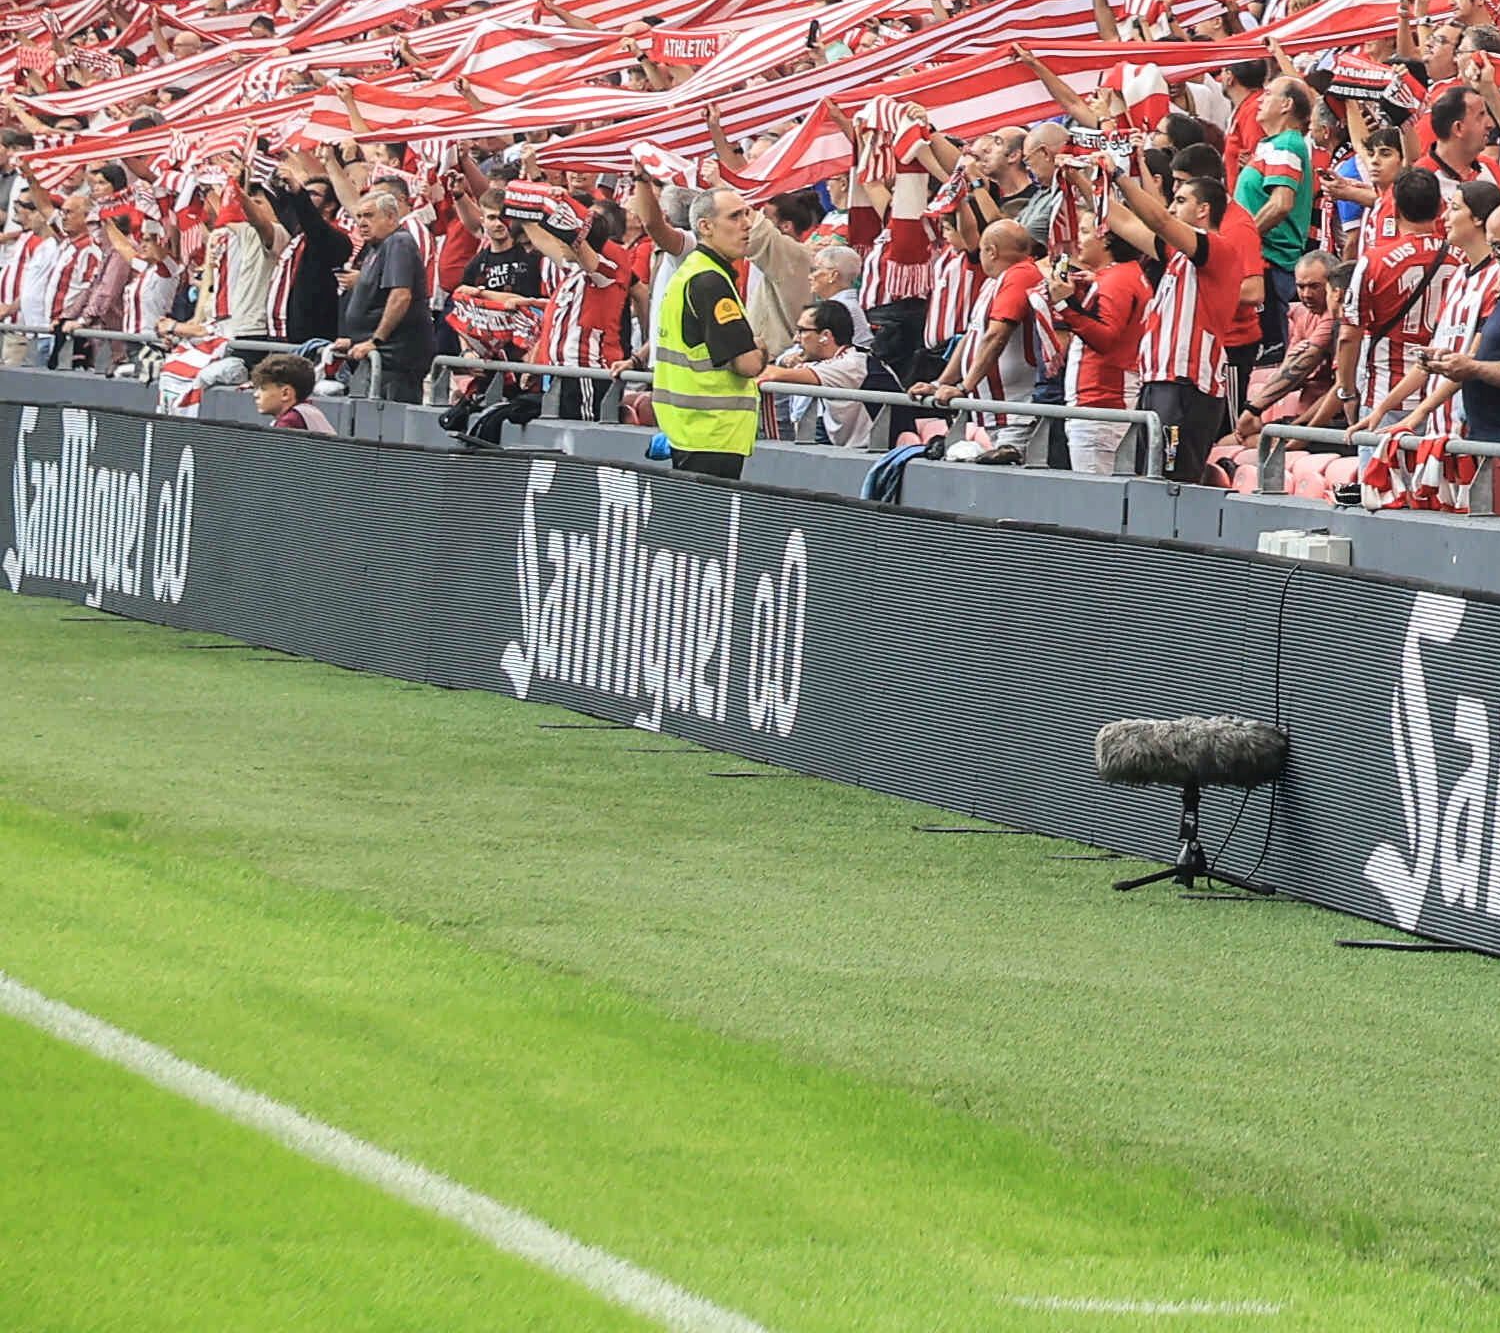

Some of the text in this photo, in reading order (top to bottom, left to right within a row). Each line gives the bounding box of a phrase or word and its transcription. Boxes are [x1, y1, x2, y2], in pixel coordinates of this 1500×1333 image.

[663, 38, 716, 56] ATHLETIC!
[1382, 235, 1468, 269] LUIS ANEL
